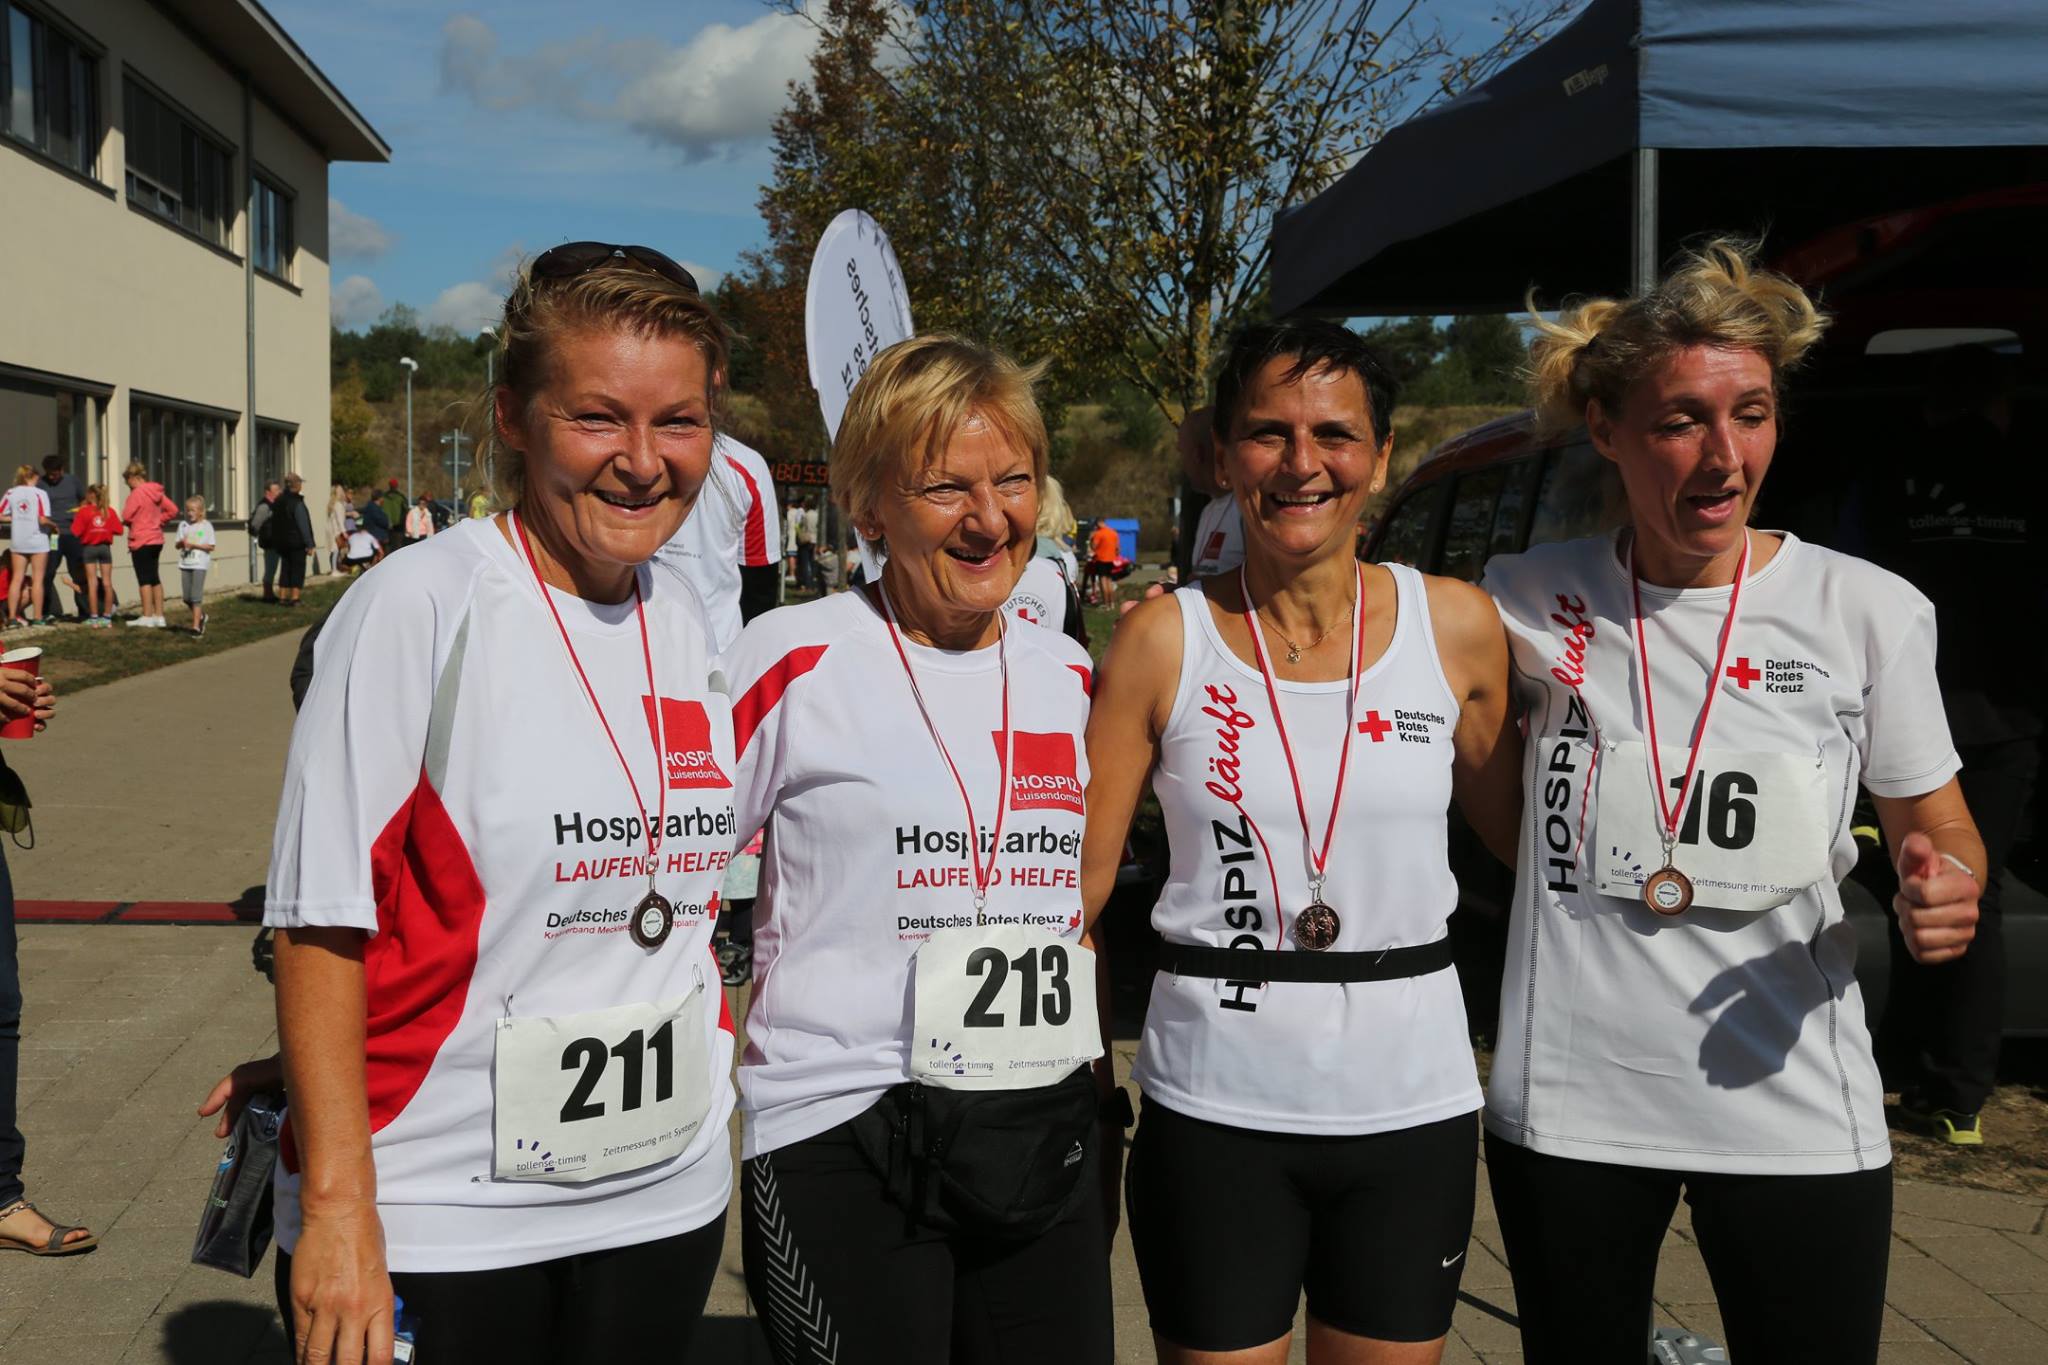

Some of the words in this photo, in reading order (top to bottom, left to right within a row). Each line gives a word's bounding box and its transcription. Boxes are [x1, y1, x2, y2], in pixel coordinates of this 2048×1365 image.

[1765, 659, 1830, 678] Deutsches
[1765, 671, 1804, 682] Rotes
[1765, 683, 1804, 693] Kreuz
[1394, 709, 1445, 725] Deutsches
[1396, 721, 1429, 732] Rotes
[1201, 684, 1255, 802] läuft
[1399, 732, 1431, 744] Kreuz
[1012, 775, 1080, 794] HOSPIZ
[1545, 695, 1588, 893] HOSPIZ
[554, 805, 736, 847] Hospzarbeit
[1011, 867, 1080, 889] HELFE
[1691, 877, 1748, 892] Zeitmessung
[1751, 884, 1767, 893] mit
[546, 908, 628, 928] Deutsches
[672, 901, 706, 915] Kreu
[897, 914, 972, 930] Deutsches
[1022, 913, 1065, 925] Kreuz
[963, 945, 1072, 1028] 213
[560, 1019, 673, 1123] 211
[929, 1060, 994, 1071] tollense-timing
[1008, 1058, 1056, 1069] Zeitmessung
[1057, 1056, 1070, 1065] mit
[602, 1136, 657, 1157] Zeitmessung
[659, 1131, 672, 1143] mit
[674, 1120, 698, 1138] System
[516, 1152, 587, 1172] tollense-timing
